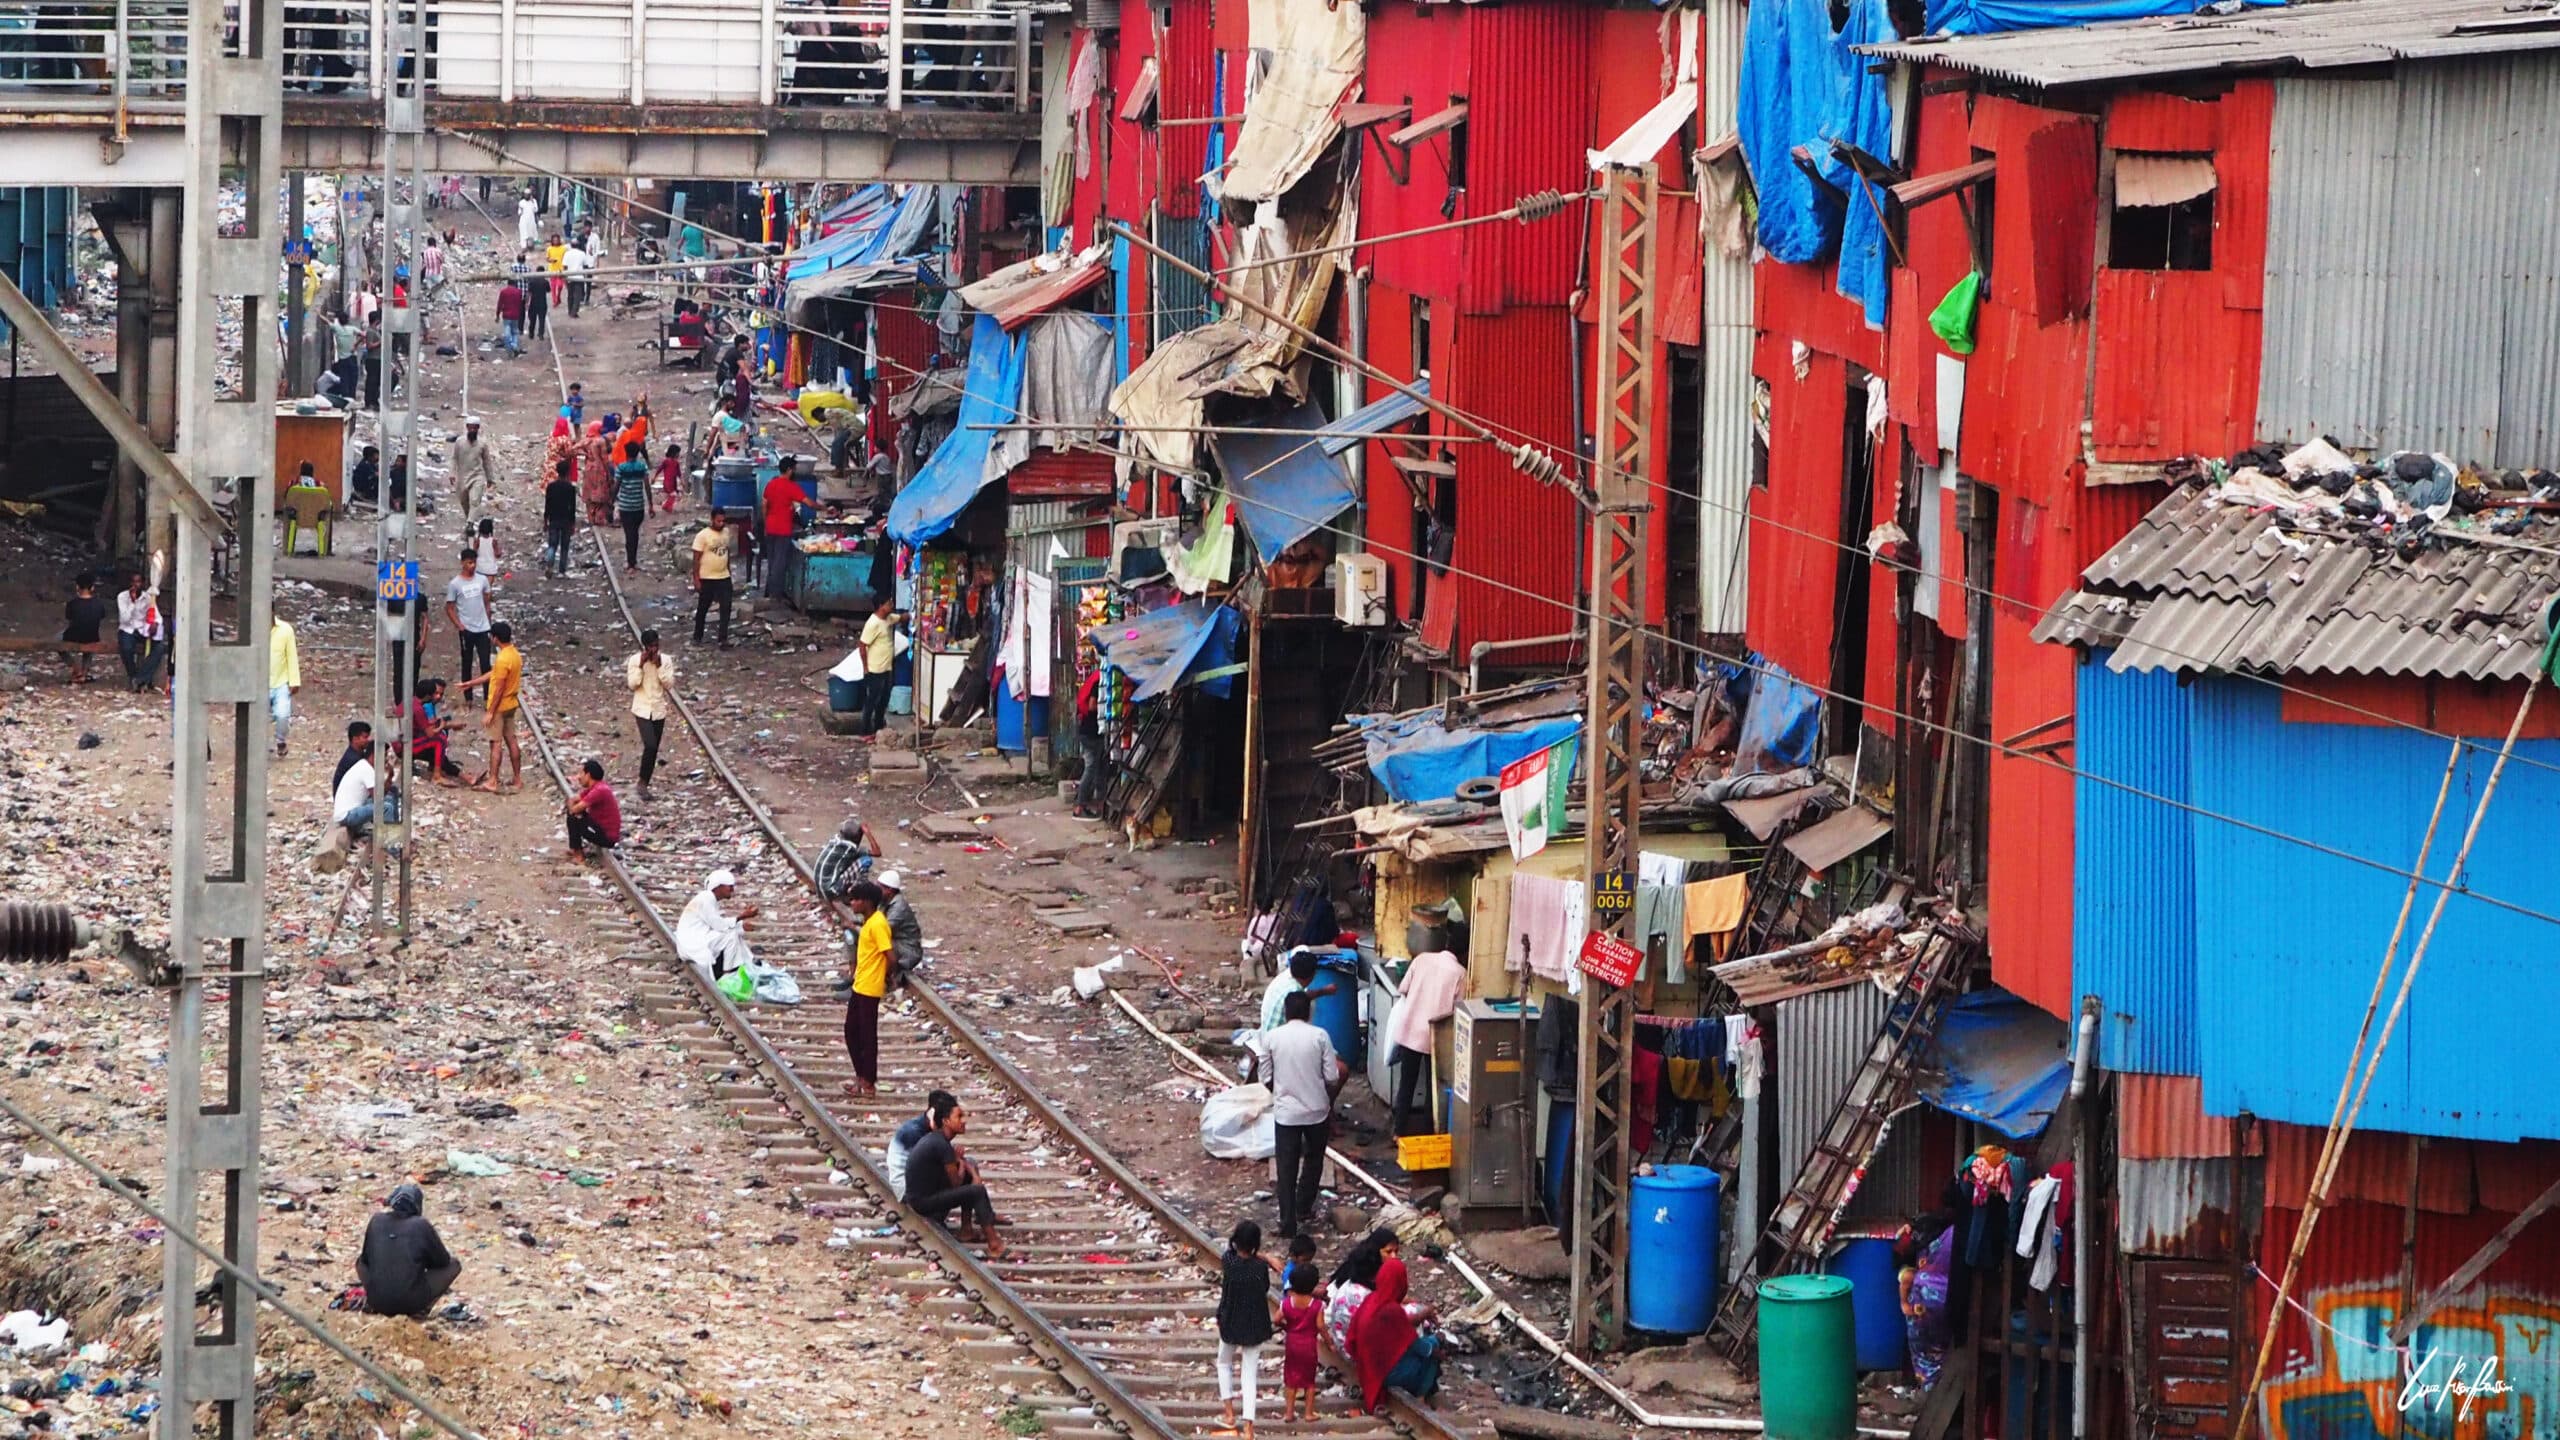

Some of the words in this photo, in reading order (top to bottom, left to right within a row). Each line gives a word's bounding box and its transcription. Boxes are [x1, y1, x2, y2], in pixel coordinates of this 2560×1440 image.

[390, 563, 406, 580] 14
[379, 581, 415, 598] 1007
[1605, 874, 1623, 890] 14
[1593, 943, 1633, 966] CLEARANCE
[1597, 936, 1635, 958] CAUTION
[1604, 956, 1615, 965] TO
[1581, 961, 1625, 987] RESTRICTED
[1601, 962, 1628, 977] NEARBY
